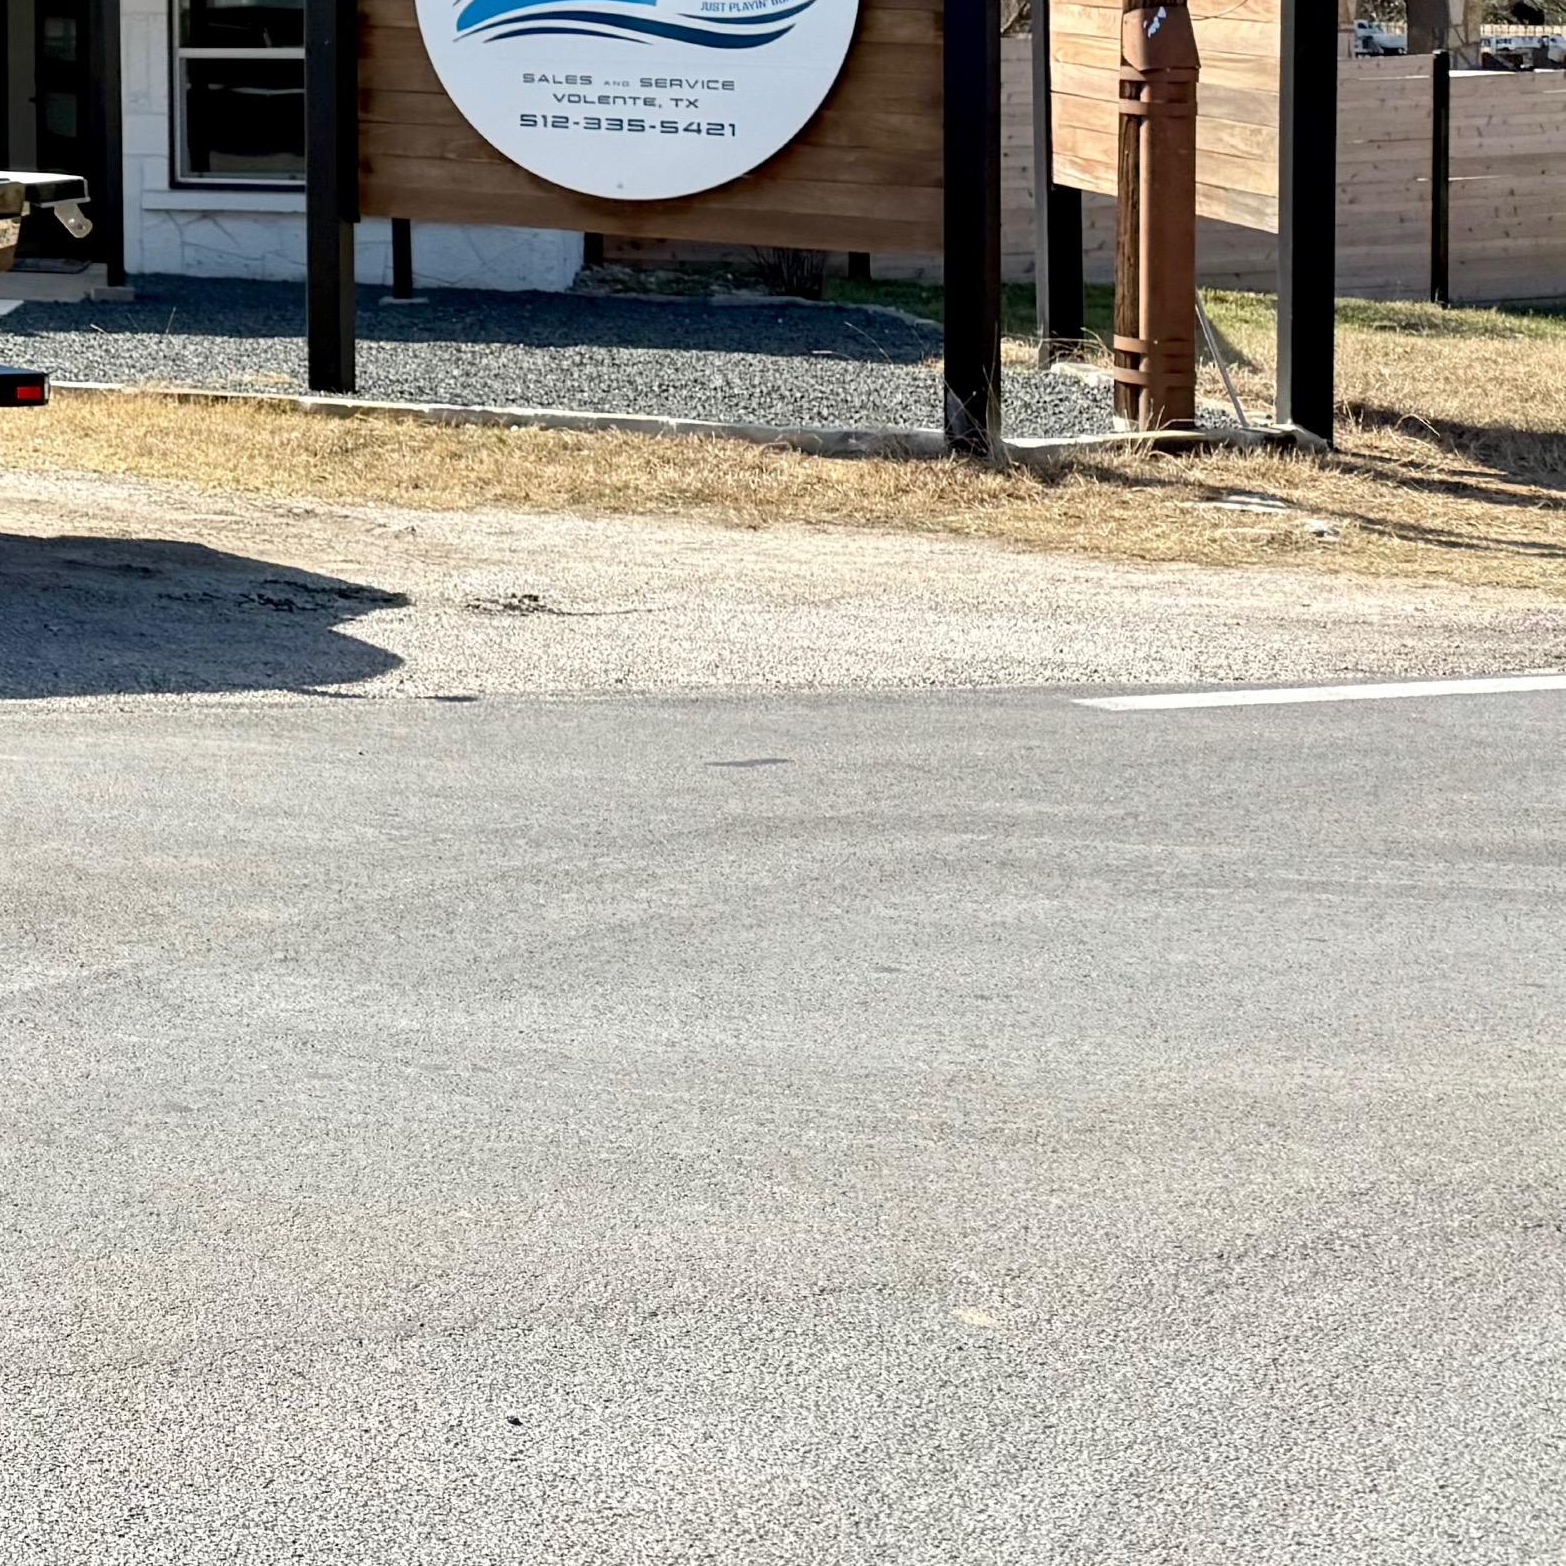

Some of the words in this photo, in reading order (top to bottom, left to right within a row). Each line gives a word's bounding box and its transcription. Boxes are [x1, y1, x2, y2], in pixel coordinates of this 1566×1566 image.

[700, 1, 726, 12] JUST
[522, 72, 593, 86] SALES
[639, 77, 736, 91] SERVICE
[552, 92, 663, 109] VOLENTE,
[669, 97, 700, 109] TX
[519, 113, 737, 137] 512-335-5421
